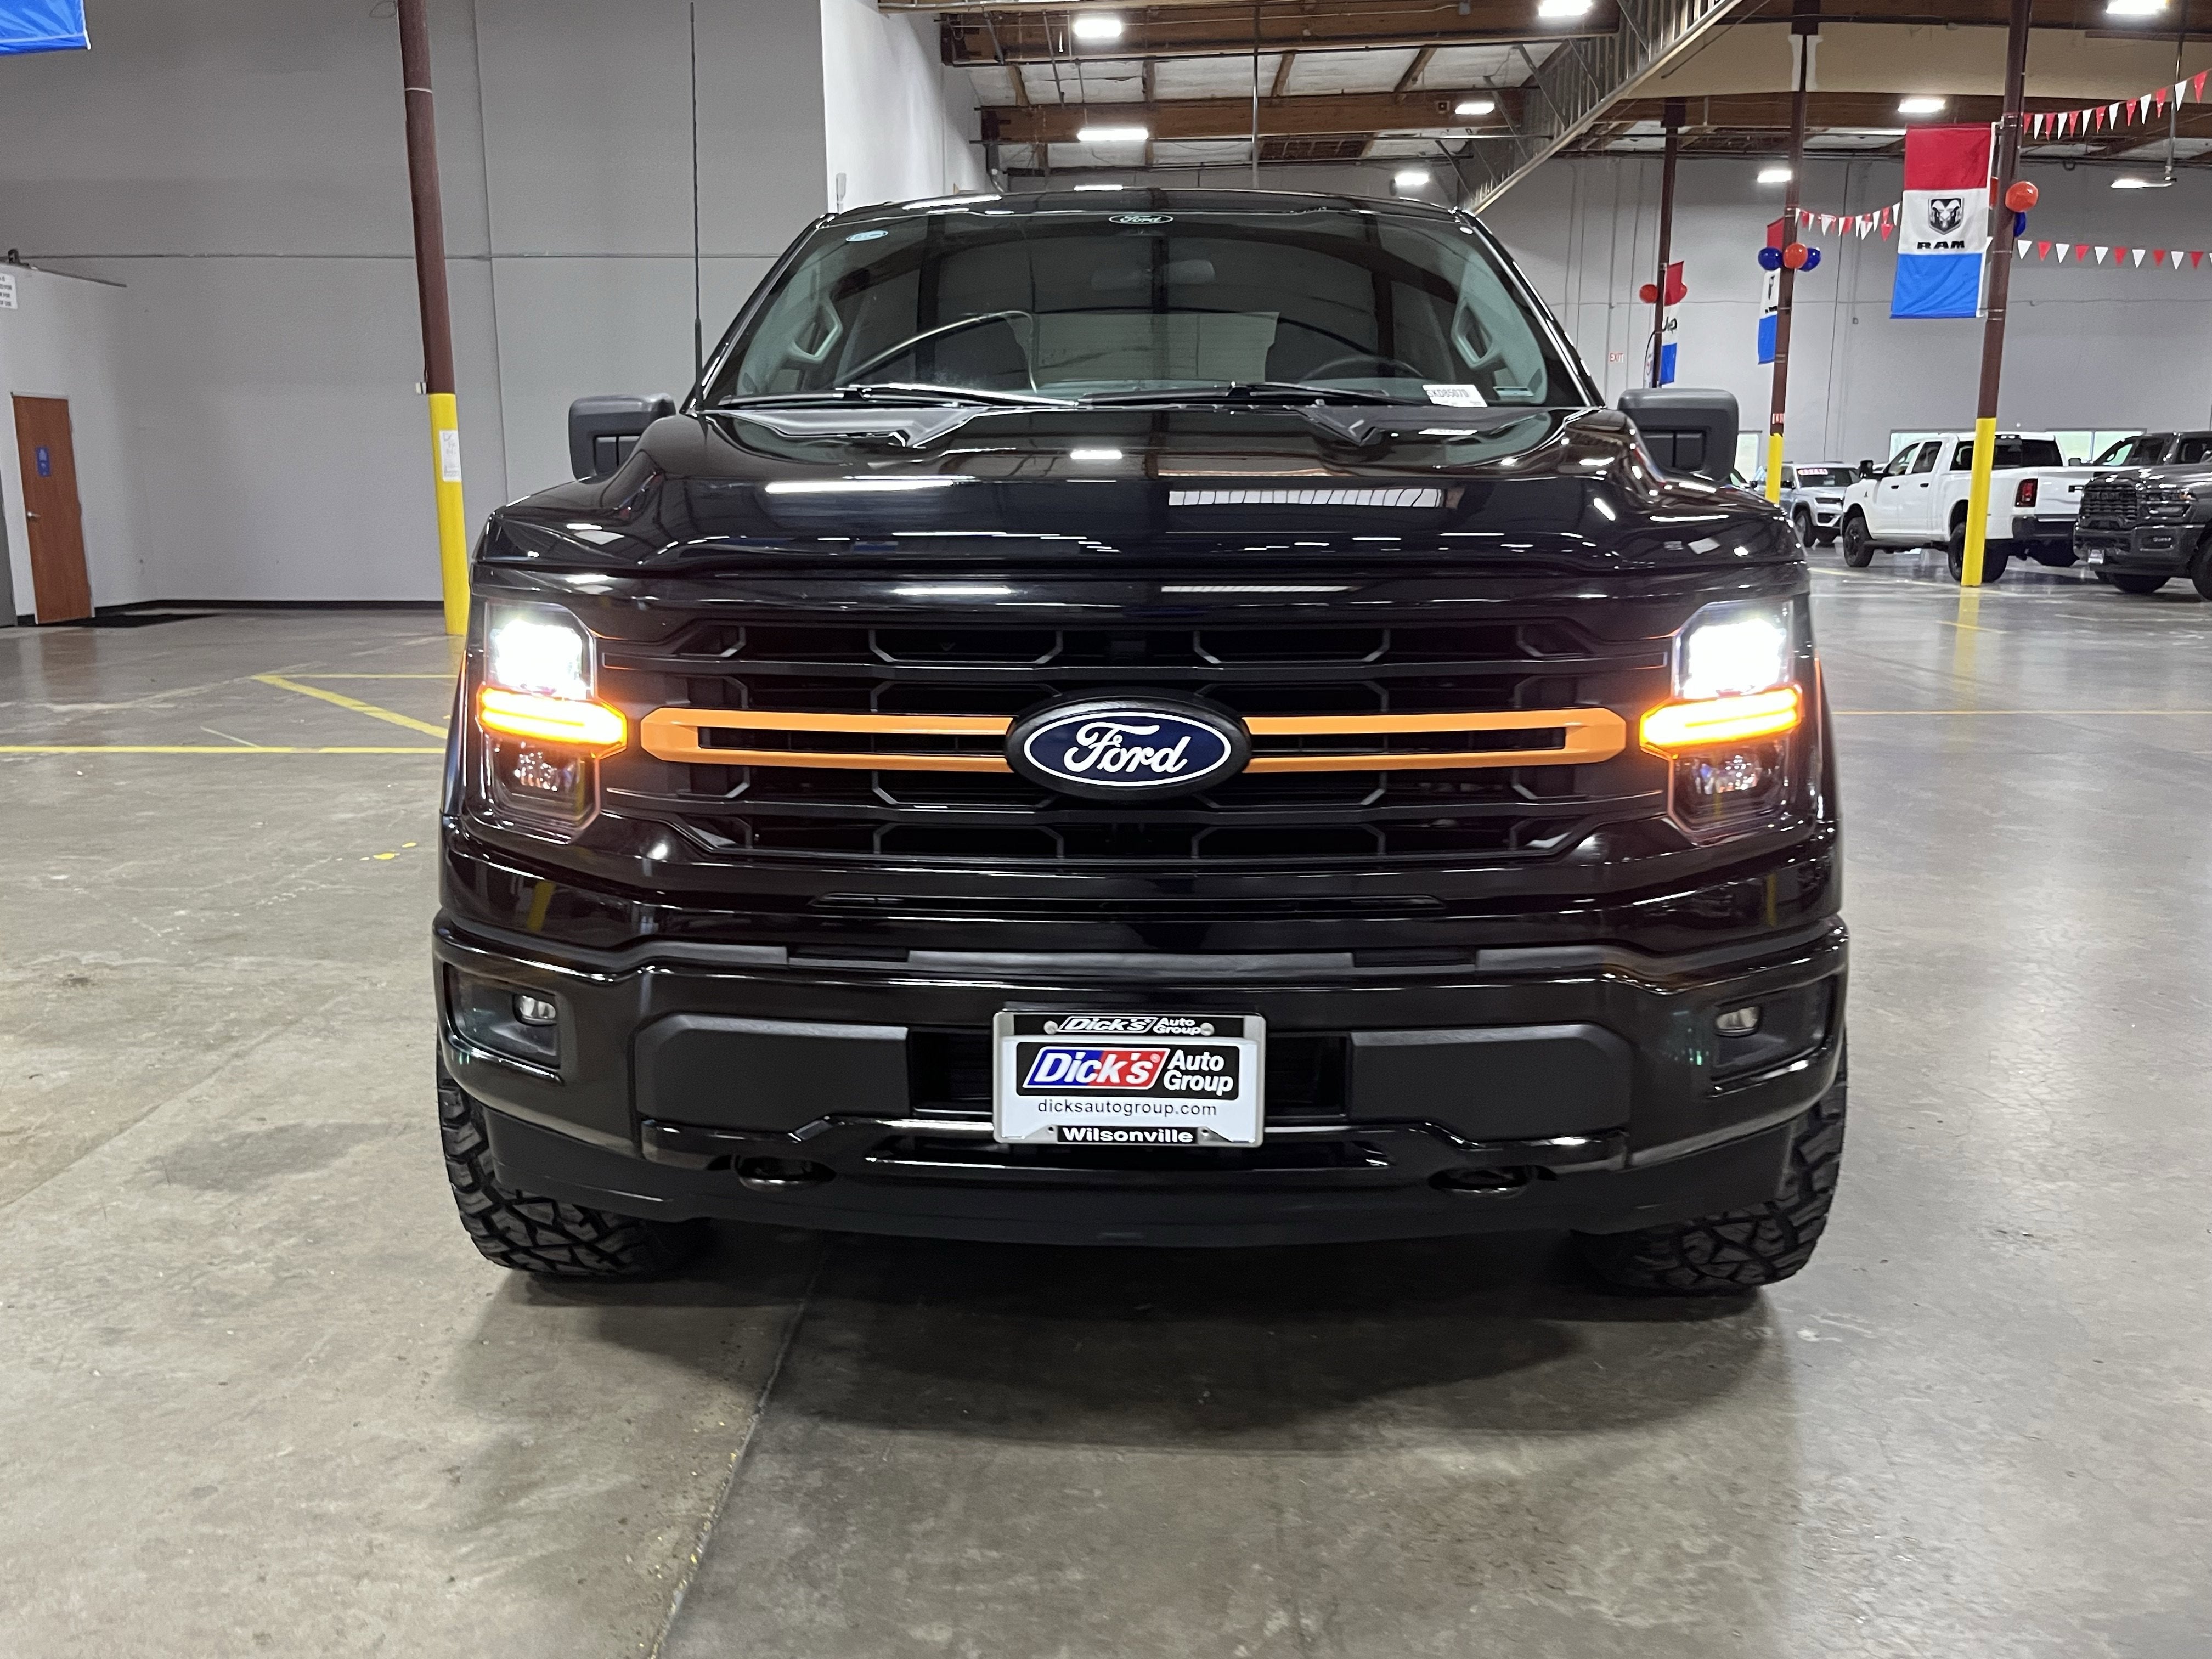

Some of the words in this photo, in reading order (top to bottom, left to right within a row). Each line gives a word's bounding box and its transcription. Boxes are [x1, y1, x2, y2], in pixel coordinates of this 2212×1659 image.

[1917, 241, 1965, 250] RAM
[1064, 722, 1192, 772] Ford
[1064, 1018, 1148, 1031] Dick's
[1157, 1018, 1195, 1026] Auto
[1153, 1025, 1201, 1036] Group
[1034, 1052, 1153, 1084] Dick's
[1167, 1050, 1224, 1071] Auto
[1163, 1070, 1234, 1096] Group
[1038, 1099, 1217, 1116] dicksautogroup.com
[1062, 1127, 1193, 1143] Wilsonville
